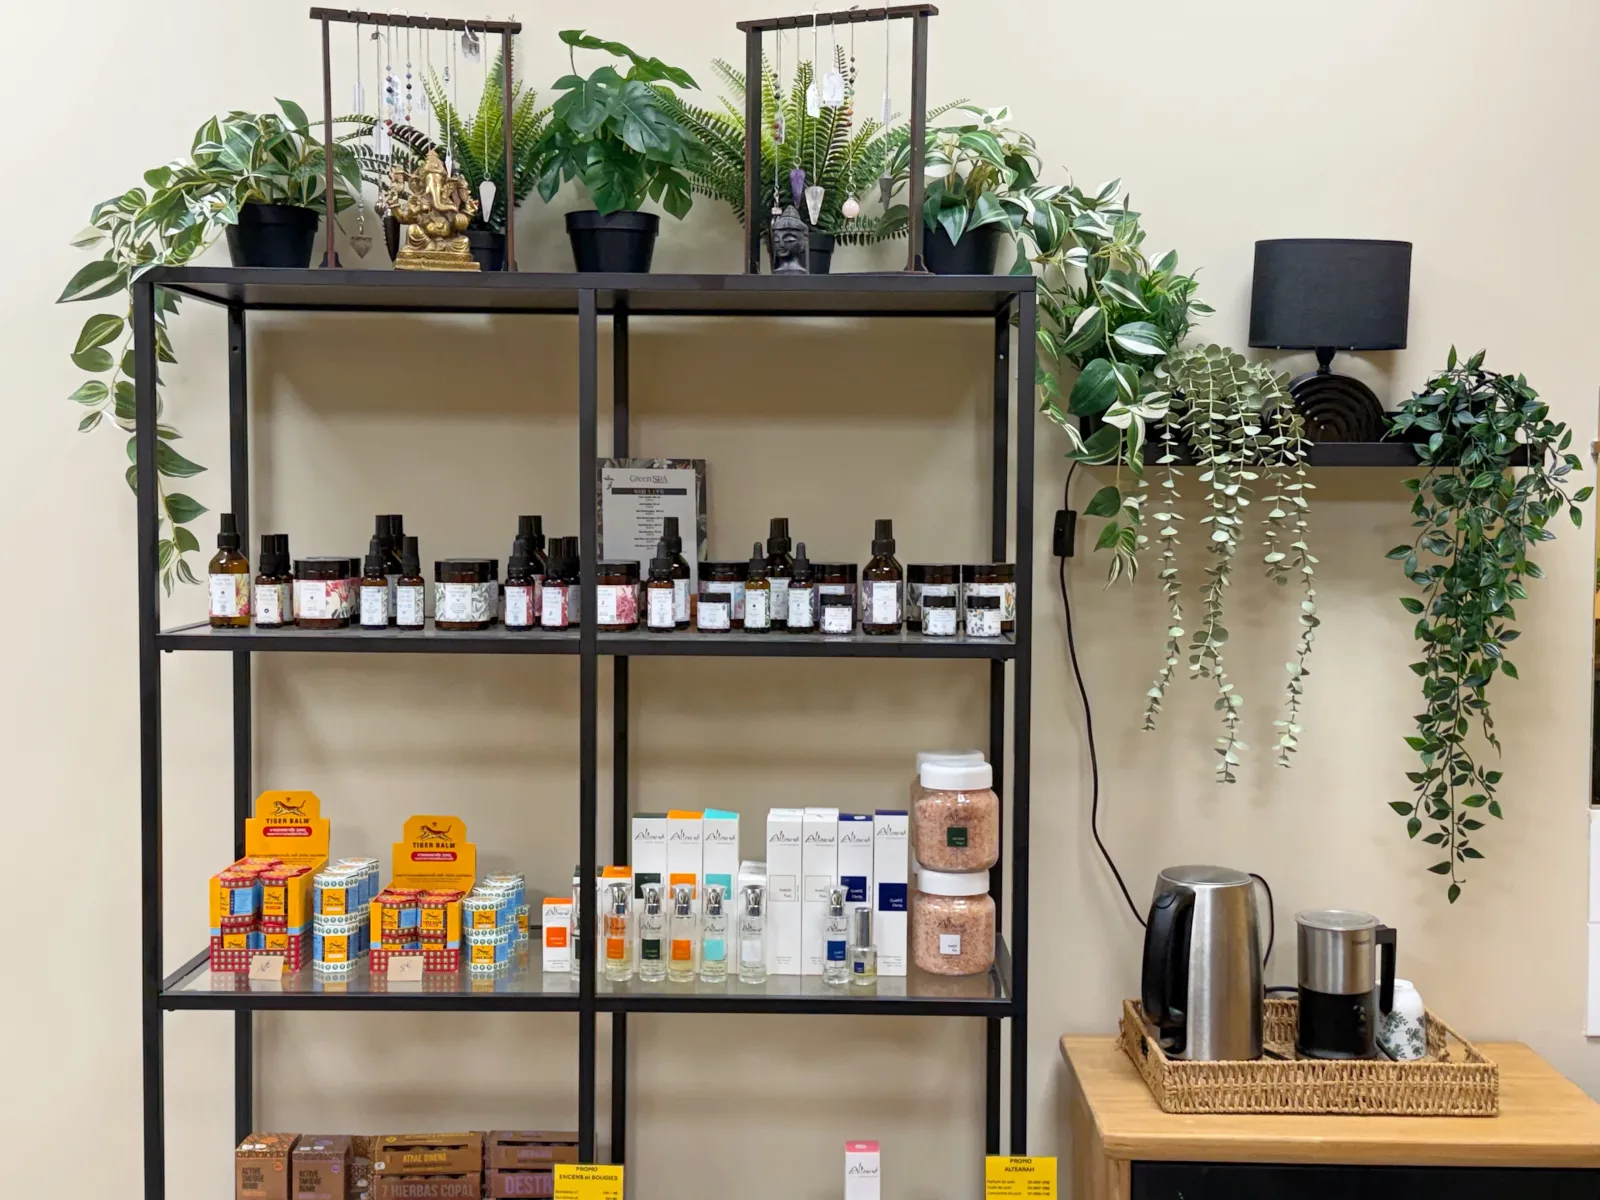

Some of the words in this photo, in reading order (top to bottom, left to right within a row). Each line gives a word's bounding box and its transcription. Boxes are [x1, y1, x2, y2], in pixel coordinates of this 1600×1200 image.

[629, 475, 652, 483] Green
[652, 475, 668, 484] SPA
[402, 1154, 423, 1162] ATRAE
[381, 1185, 388, 1197] 7
[391, 1183, 438, 1198] HIERBAS
